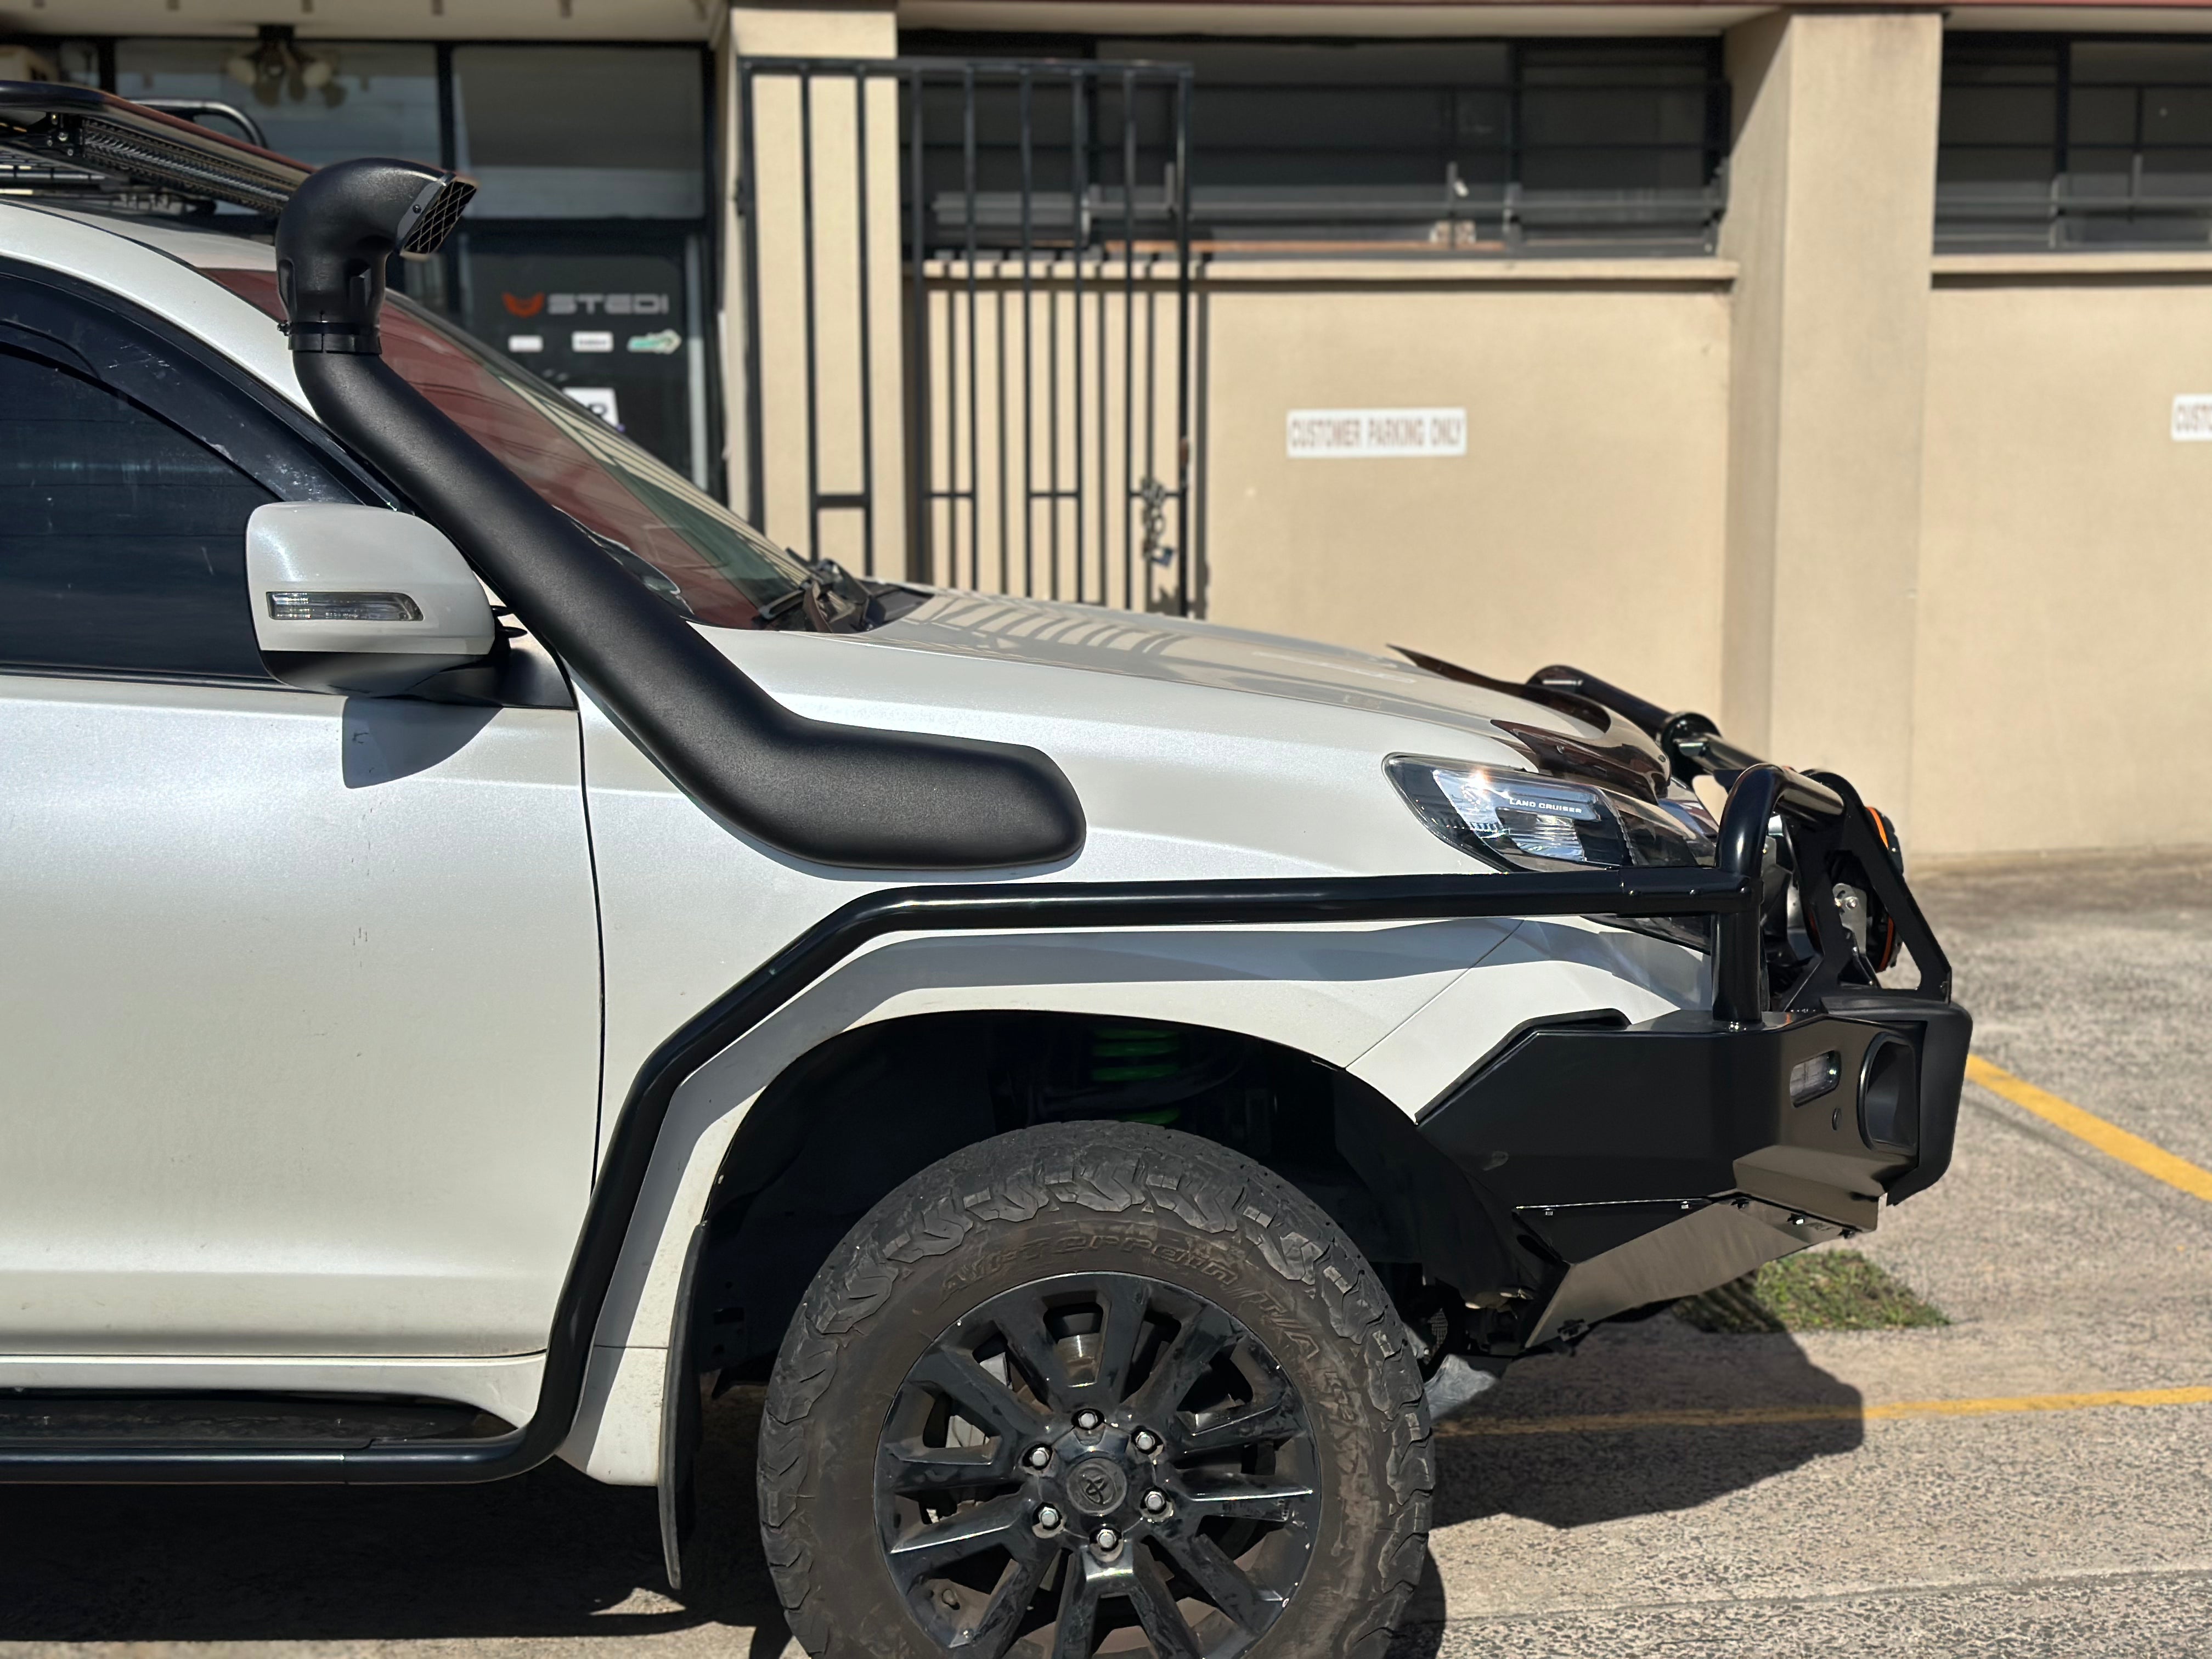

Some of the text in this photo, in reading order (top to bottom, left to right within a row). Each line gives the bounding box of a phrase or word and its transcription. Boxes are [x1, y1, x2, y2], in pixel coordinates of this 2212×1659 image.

[547, 294, 669, 314] STEDI
[1289, 416, 1462, 448] CUSTOMER PARKING ONLY
[1510, 798, 1582, 814] LAND CRUISER
